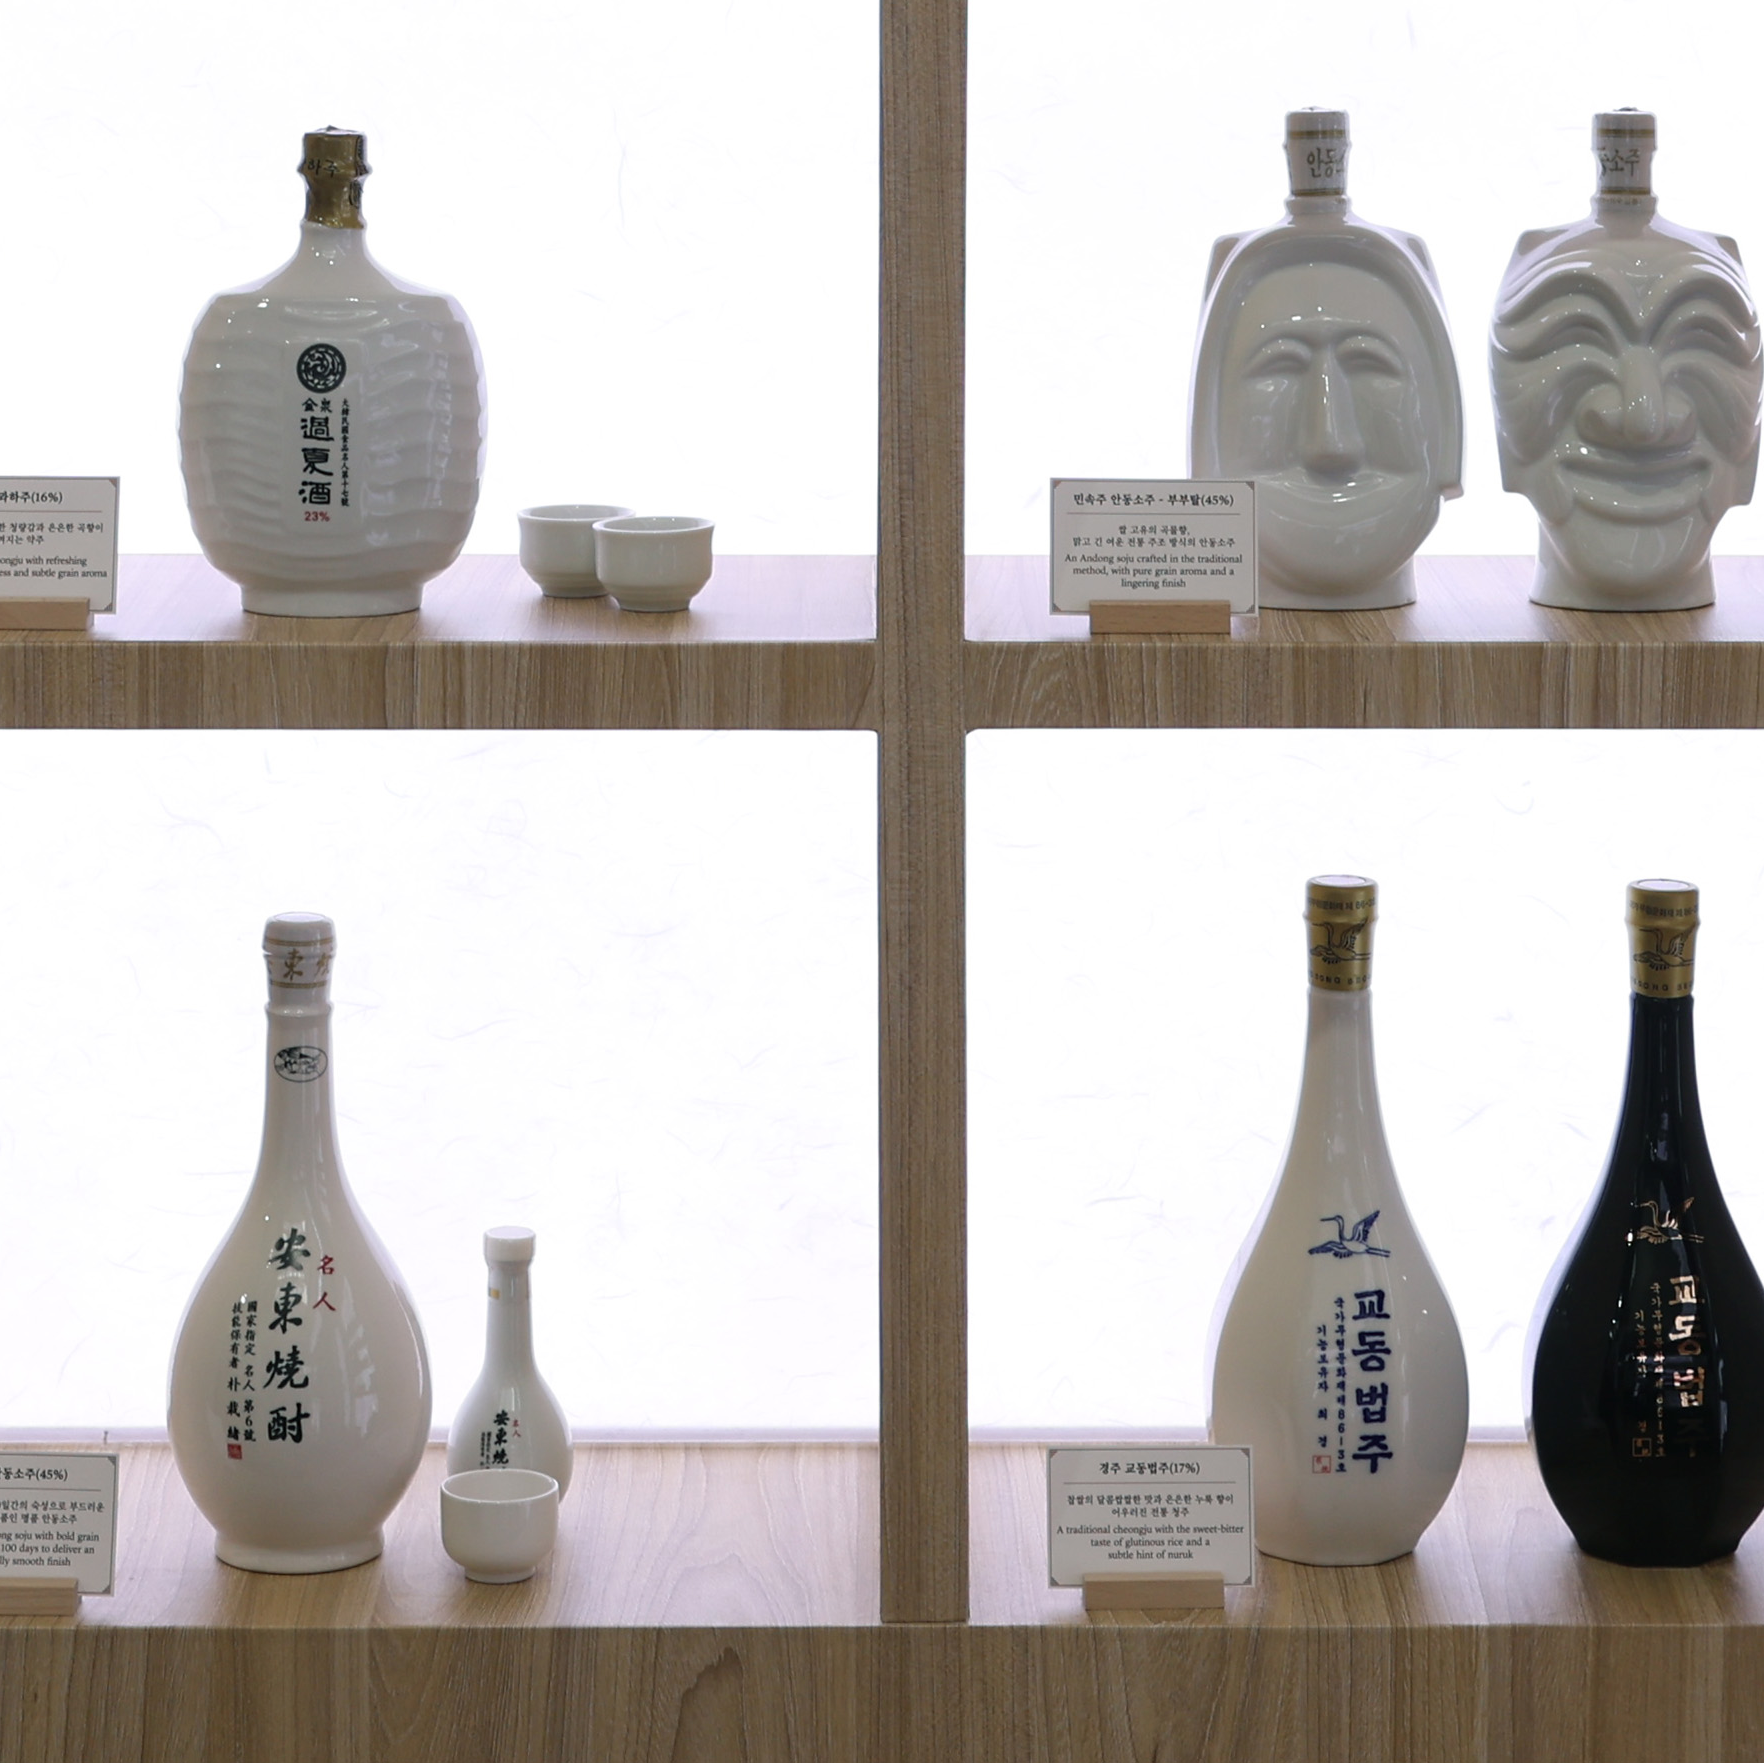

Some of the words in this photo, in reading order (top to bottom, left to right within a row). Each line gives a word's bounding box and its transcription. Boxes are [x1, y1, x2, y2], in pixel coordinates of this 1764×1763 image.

[301, 397, 333, 413] 金泉
[298, 415, 335, 506] 過夏酒
[304, 511, 331, 522] 23%
[1073, 492, 1106, 505] 민속주
[1110, 493, 1155, 506] 안동소주
[13, 567, 29, 577] and
[31, 567, 56, 577] subtle
[57, 570, 79, 580] grain
[80, 570, 107, 578] aroma
[313, 1254, 337, 1312] 名人
[262, 1227, 311, 1444] 安東燒酎
[1317, 1325, 1329, 1393] 기능보유자
[1351, 1288, 1394, 1474] 교동법주
[492, 1409, 510, 1468] 安東燒
[1100, 1461, 1121, 1475] 경주
[1065, 1524, 1110, 1534] traditional
[1112, 1524, 1152, 1536] cheongju
[1154, 1524, 1174, 1533] with
[1175, 1524, 1190, 1534] the
[1192, 1524, 1244, 1534] sweet-bitter
